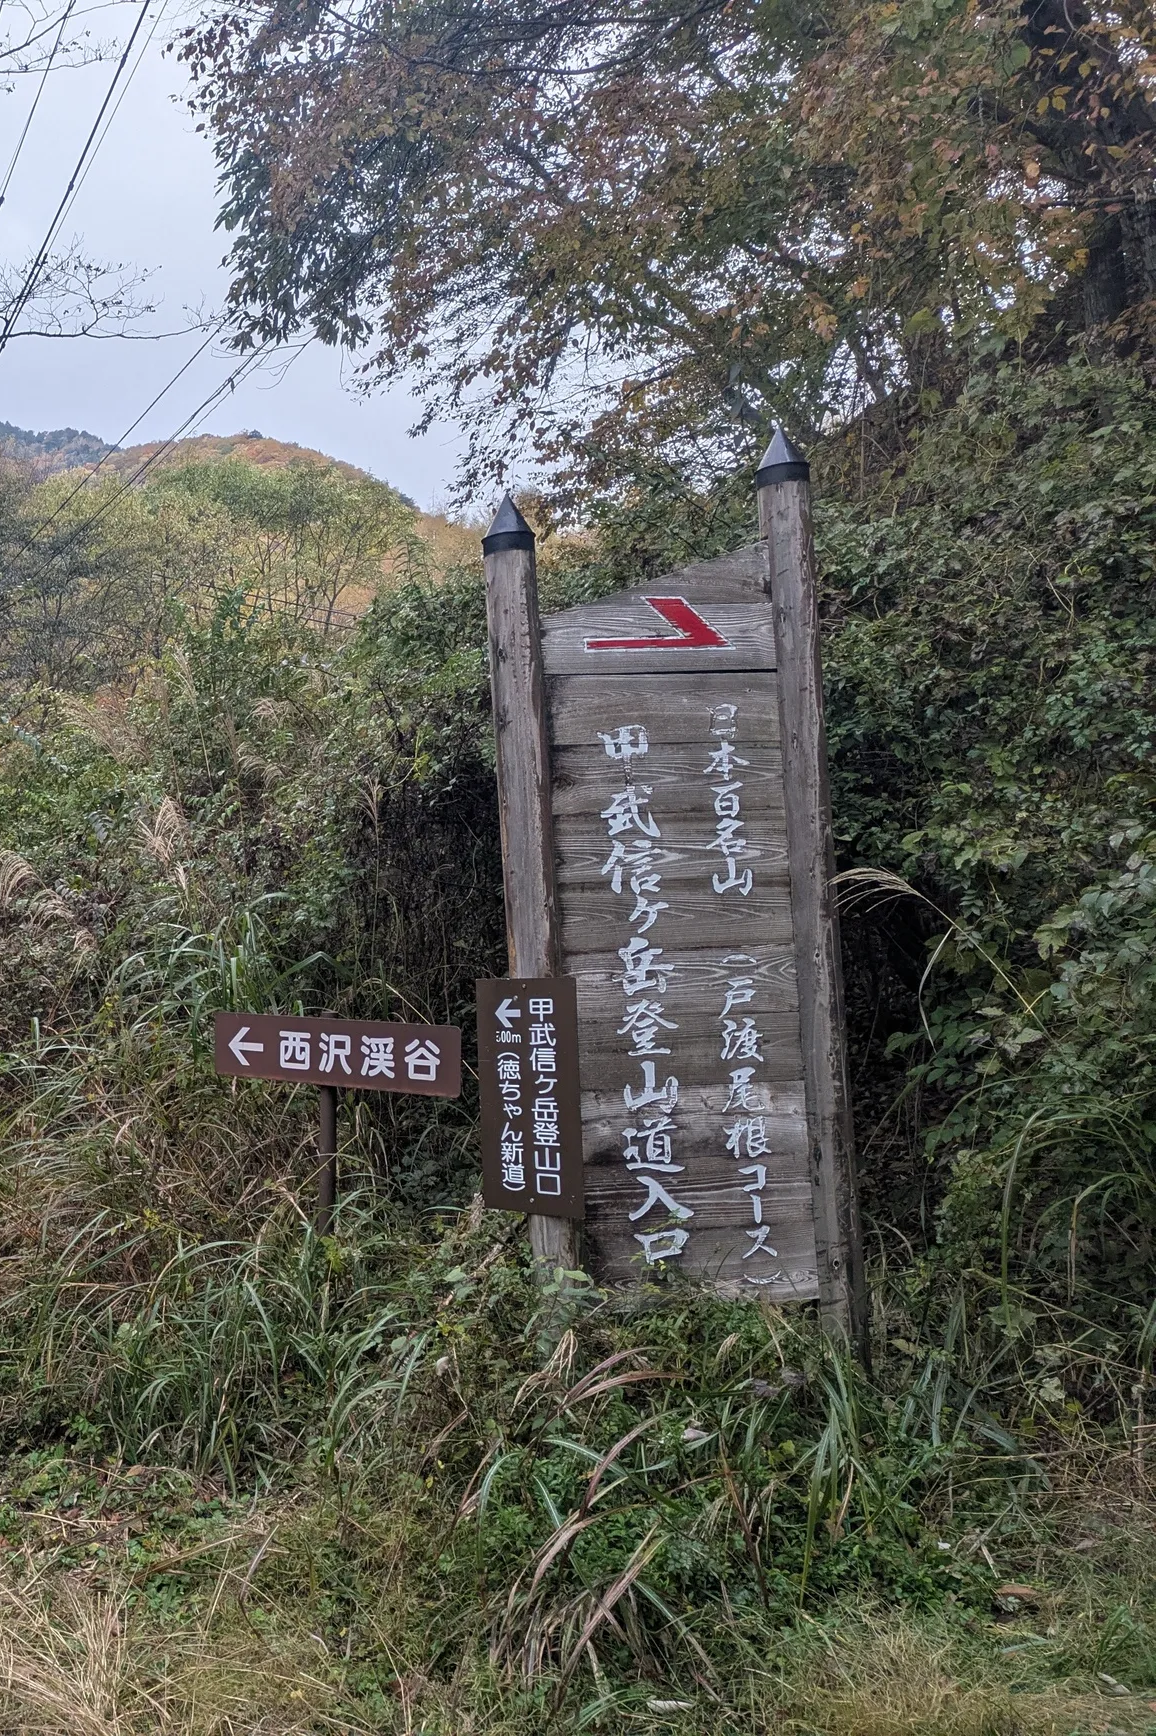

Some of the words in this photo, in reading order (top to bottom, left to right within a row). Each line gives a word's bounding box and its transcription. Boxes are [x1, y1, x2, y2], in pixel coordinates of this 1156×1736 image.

[703, 703, 753, 897] 日本百名山
[279, 1030, 441, 1082] 西沢渓谷
